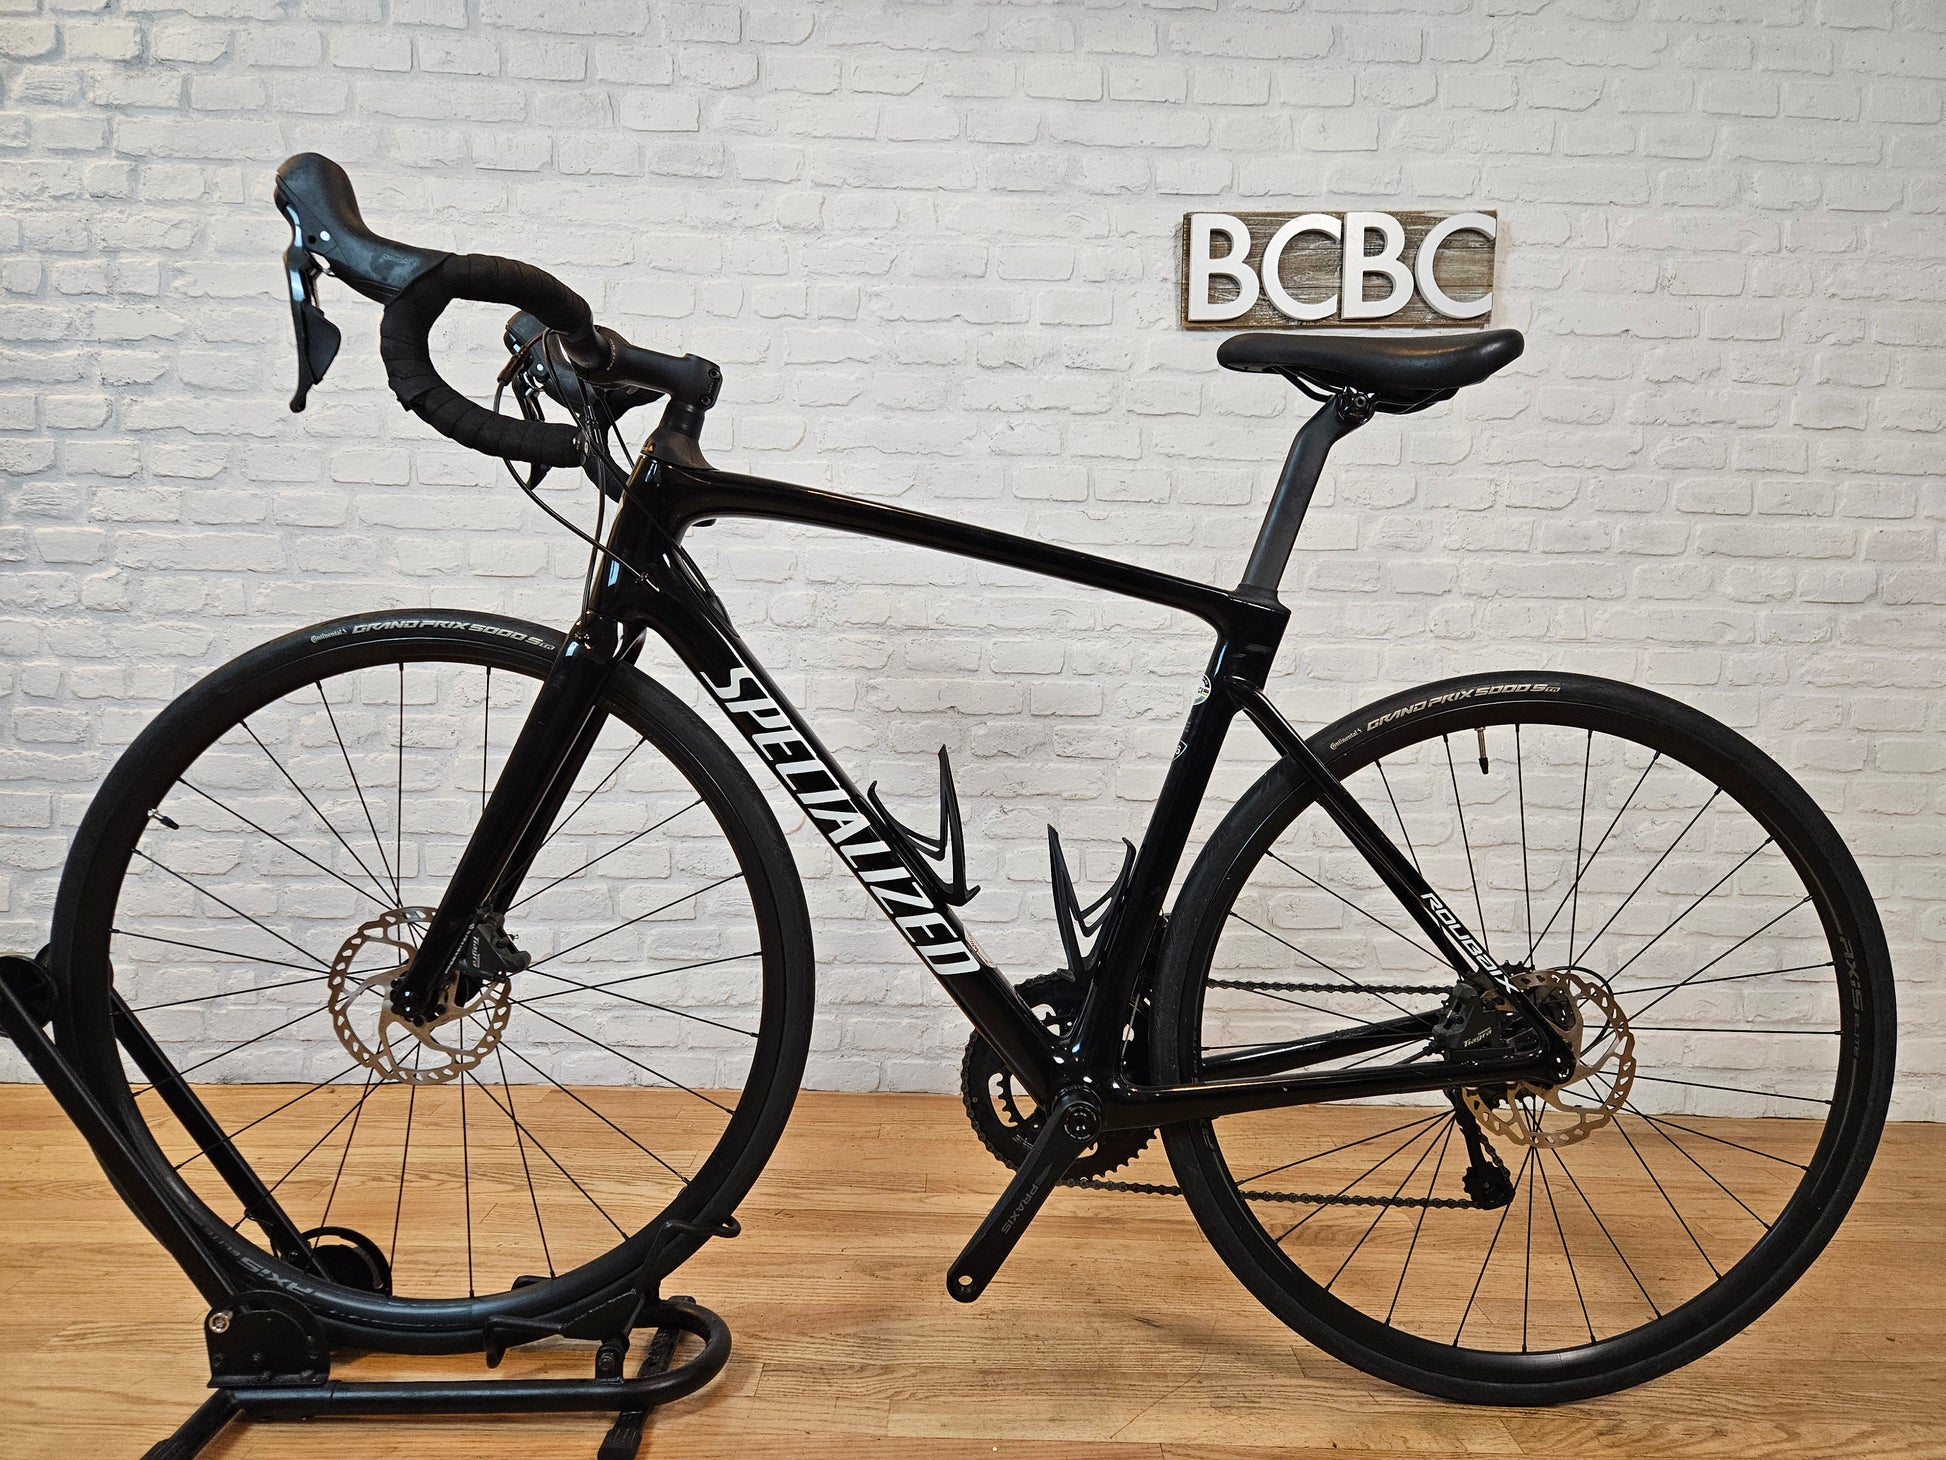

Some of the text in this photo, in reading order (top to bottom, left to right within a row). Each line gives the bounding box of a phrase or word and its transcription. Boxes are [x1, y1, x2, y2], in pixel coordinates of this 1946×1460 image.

[1188, 211, 1497, 321] BCBC
[310, 629, 342, 643] Continental
[352, 620, 419, 635] GRAND
[417, 619, 468, 631] PRIX
[468, 624, 528, 641] 5000
[1366, 701, 1428, 732] GRAND
[1427, 689, 1475, 708] PRIX
[1474, 683, 1532, 697] 5000
[1330, 729, 1359, 750] Continental
[699, 667, 981, 975] SPECIALIZED
[1001, 1184, 1039, 1234] PRAXIS
